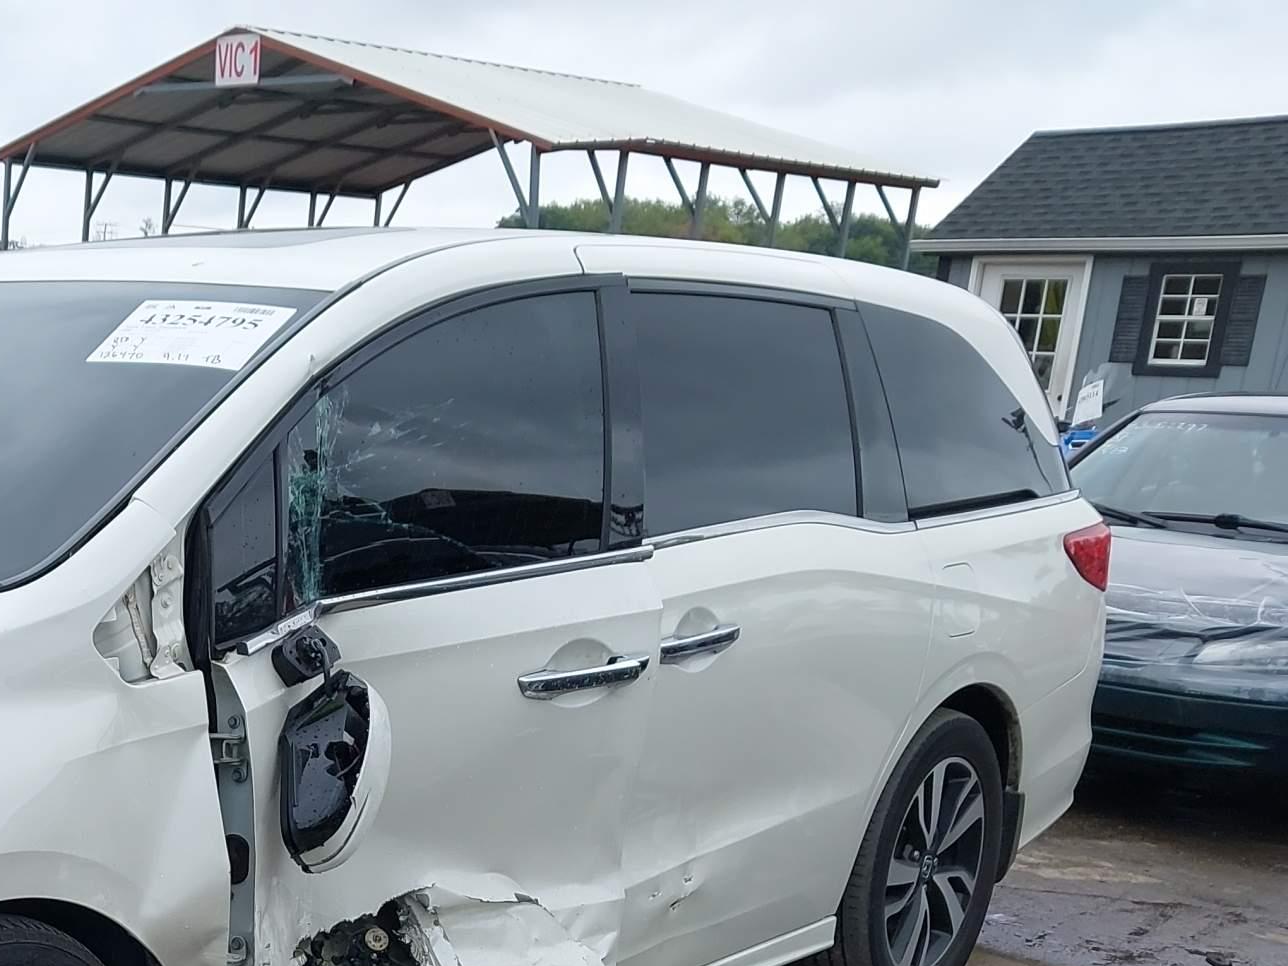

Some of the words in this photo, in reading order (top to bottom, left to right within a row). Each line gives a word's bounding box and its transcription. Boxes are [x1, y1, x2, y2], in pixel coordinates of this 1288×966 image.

[218, 41, 245, 78] VIC
[249, 39, 259, 76] 1
[140, 313, 263, 330] 43254795
